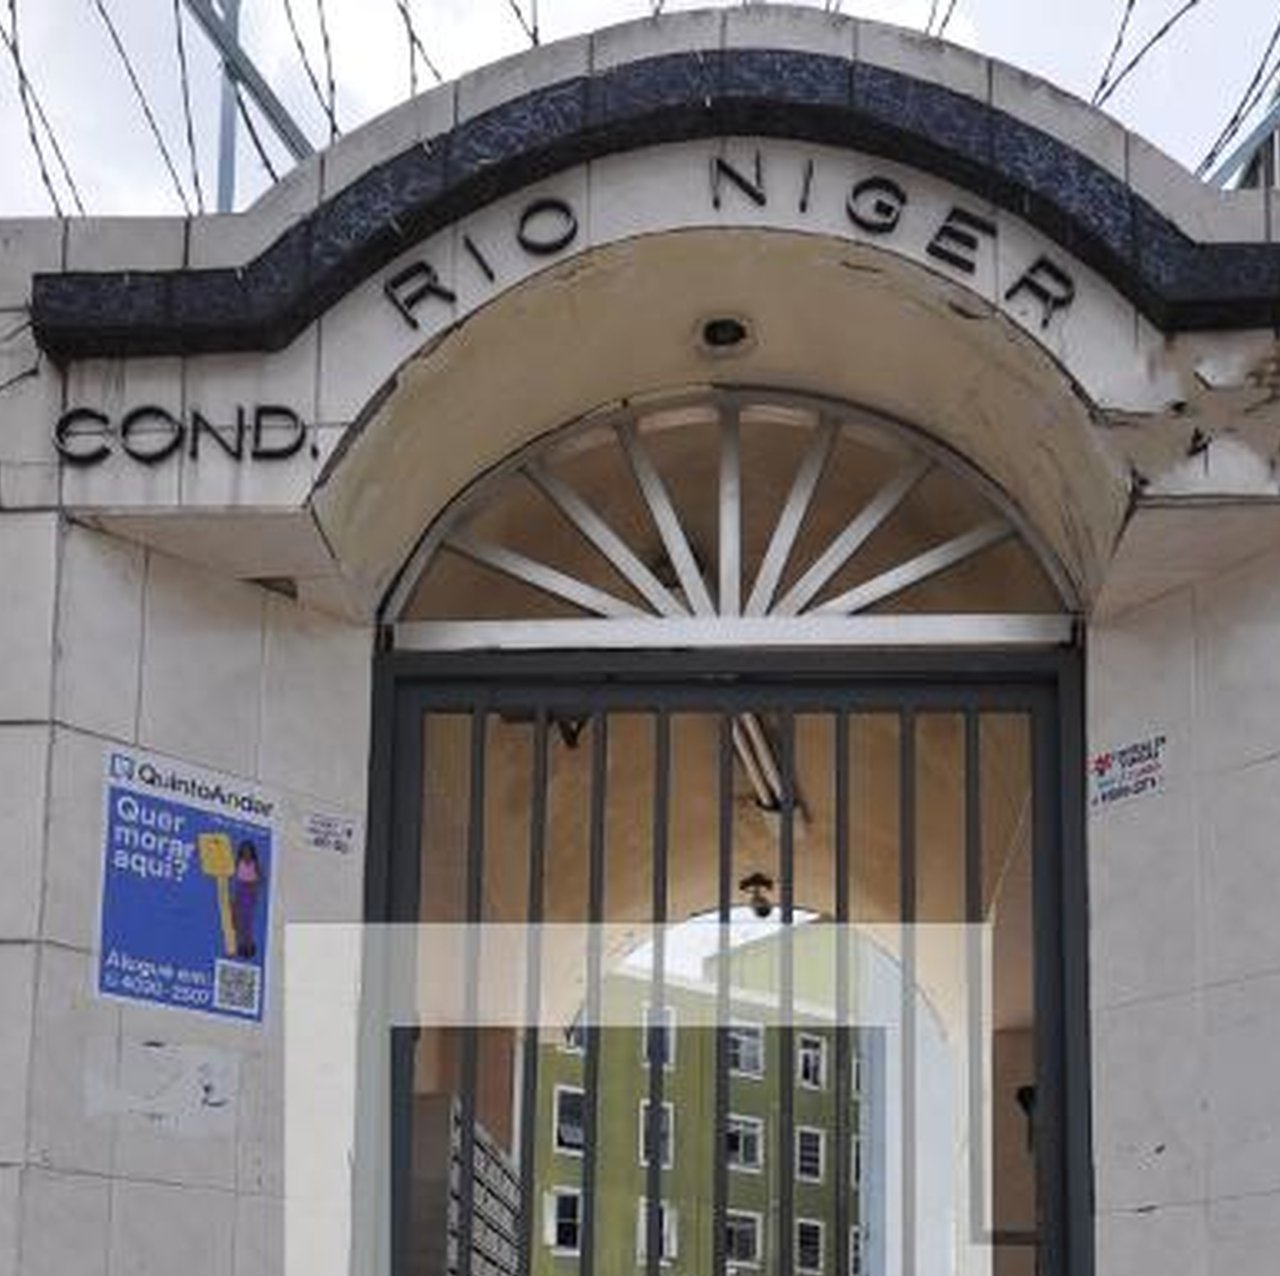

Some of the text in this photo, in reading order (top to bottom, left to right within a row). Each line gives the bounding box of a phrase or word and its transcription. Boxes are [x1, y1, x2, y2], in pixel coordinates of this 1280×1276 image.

[54, 148, 1076, 467] COND. RIO NIGER
[137, 763, 274, 817] QuintoAndar
[117, 796, 186, 832] Quer
[113, 826, 195, 858] morar
[113, 849, 187, 882] aqui?
